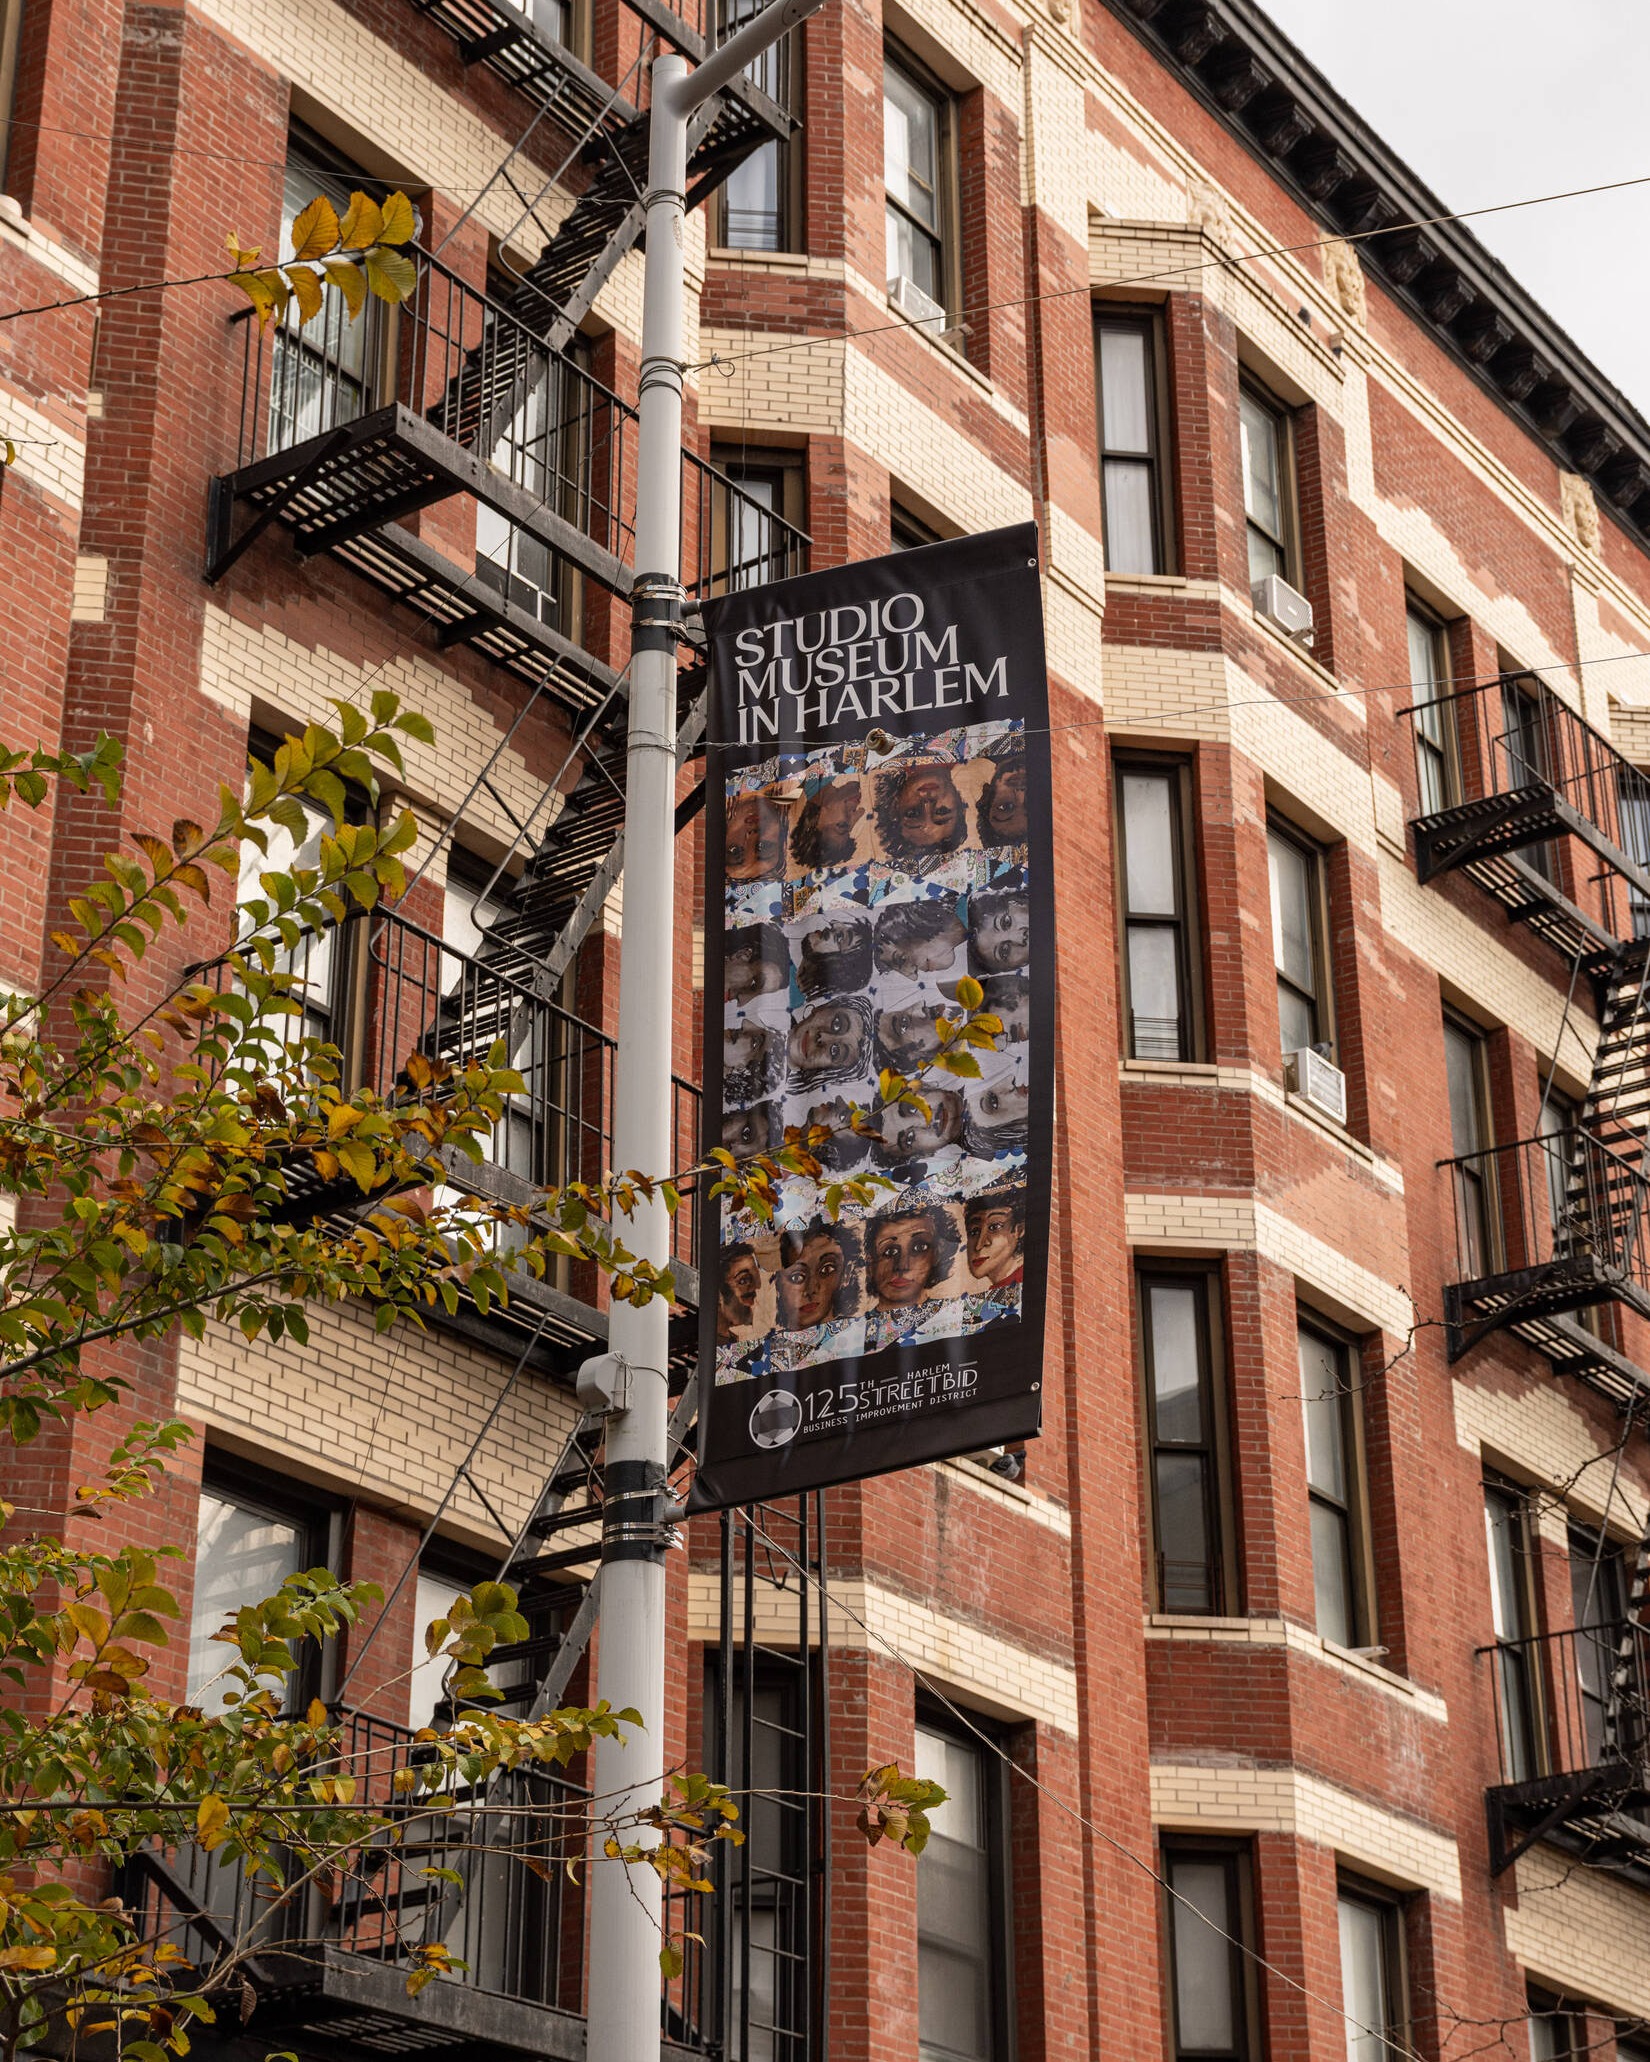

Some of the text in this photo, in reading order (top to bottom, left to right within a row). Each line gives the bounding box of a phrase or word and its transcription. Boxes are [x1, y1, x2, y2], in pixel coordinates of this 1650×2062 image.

[735, 593, 924, 667] STUDIO
[737, 625, 959, 706] MUSEUM
[737, 655, 1009, 744] IN HARLEM
[907, 1363, 950, 1379] HARLEM
[803, 1388, 977, 1434] BUSINESS IMPROVEMENT DISTRICT
